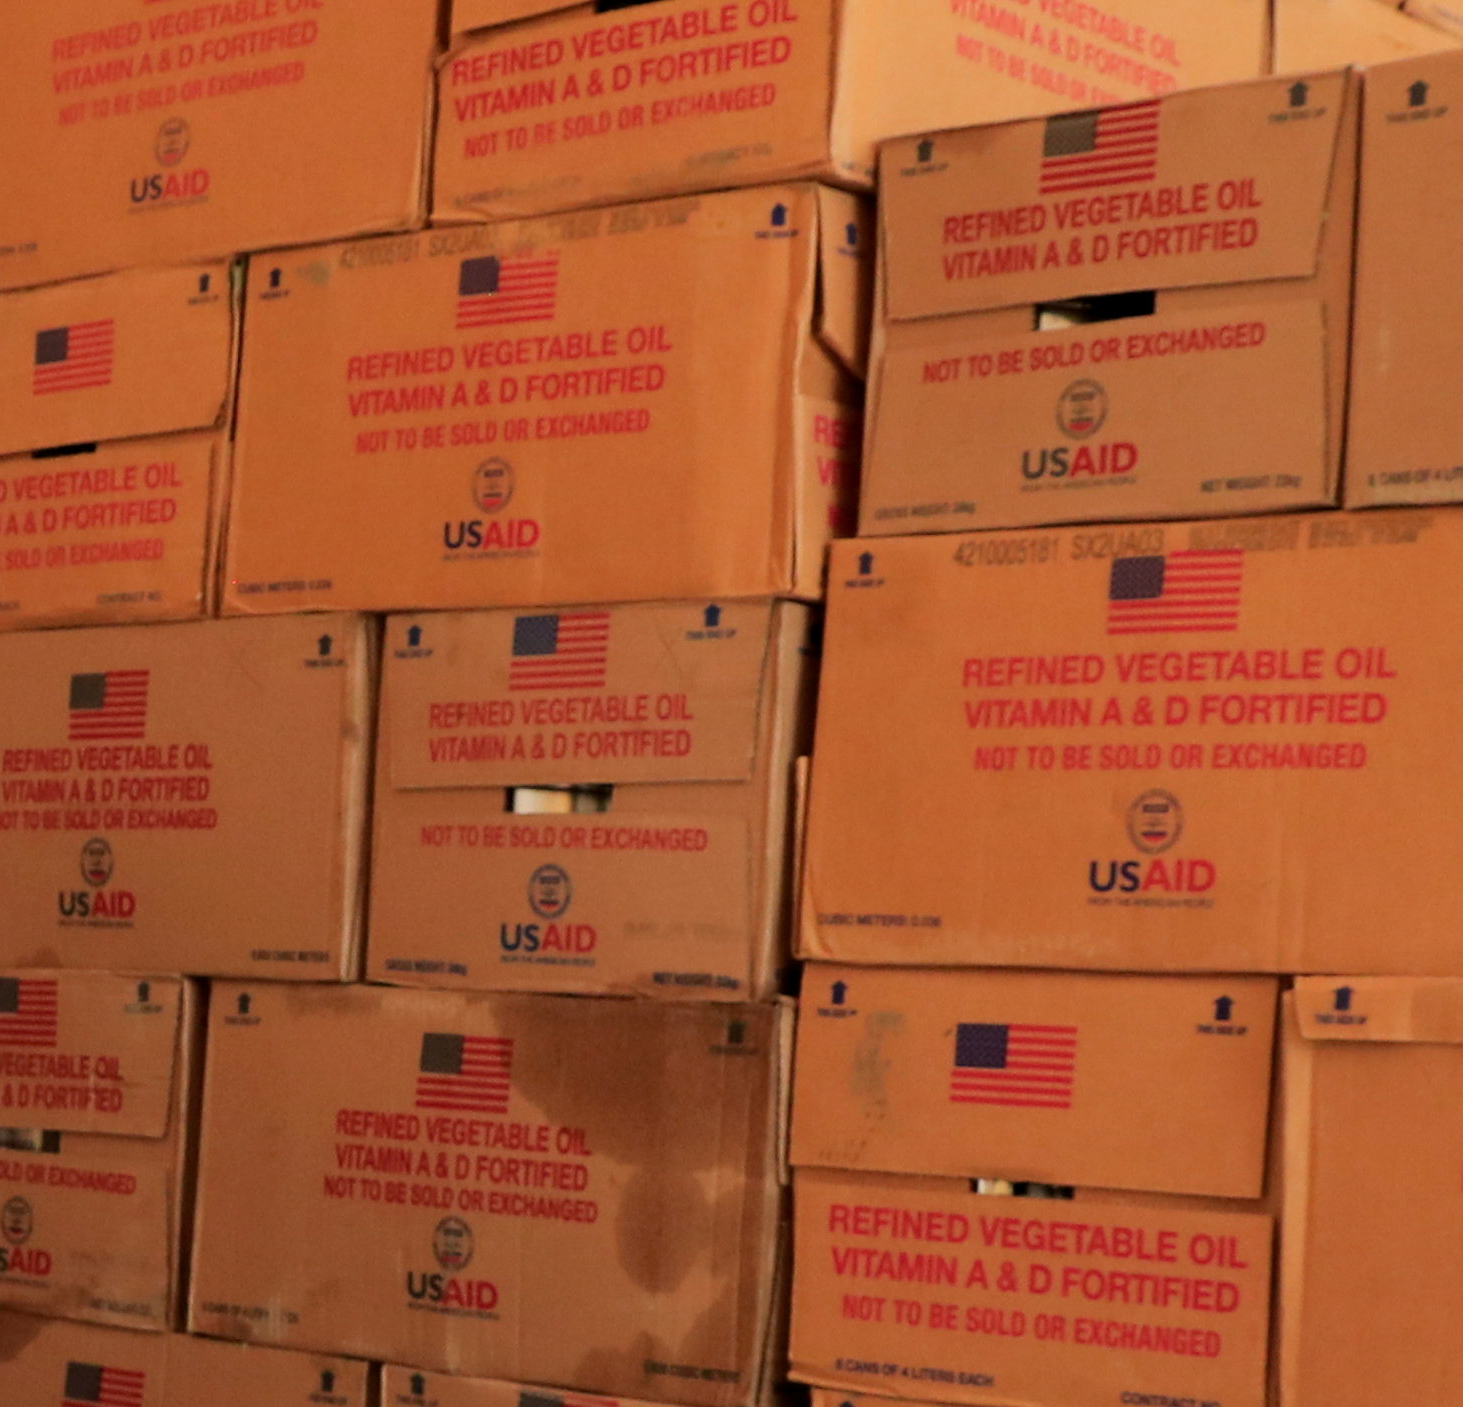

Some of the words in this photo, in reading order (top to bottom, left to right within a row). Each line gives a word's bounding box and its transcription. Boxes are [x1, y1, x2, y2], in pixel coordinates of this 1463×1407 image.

[944, 204, 1047, 244] REFINED
[1054, 184, 1208, 230] VEGETABLE
[1217, 177, 1261, 211] OIL
[943, 243, 1037, 279] VITAMIN
[1042, 241, 1060, 268] A
[1066, 236, 1084, 266] &
[1091, 233, 1110, 263] D
[1117, 216, 1258, 261] FORTIFIED
[347, 346, 455, 381] REFINED
[463, 330, 617, 369] VEGETABLE
[626, 324, 672, 354] OIL
[923, 358, 962, 383] NOT
[968, 354, 993, 378] TO
[997, 349, 1023, 374] BE
[1029, 342, 1085, 370] SOLD
[1089, 337, 1121, 363] OR
[1126, 320, 1266, 359] EXCHANGED
[349, 384, 446, 415] VITAMIN
[451, 381, 468, 406] A
[474, 379, 492, 406] &
[499, 376, 519, 403] D
[525, 363, 666, 401] FORTIFIED
[356, 430, 390, 453] NOT
[396, 427, 418, 449] TO
[422, 425, 444, 448] BE
[451, 420, 498, 445] SOLD
[503, 418, 529, 441] OR
[535, 408, 650, 439] EXCHANGED
[1023, 442, 1138, 479] USAID
[444, 518, 539, 549] USAID
[952, 536, 1058, 567] 4210005181
[963, 655, 1105, 686] REFINED
[1116, 648, 1323, 683] VEGETABLE
[1335, 647, 1396, 678] OIL
[430, 700, 515, 728] REFINED
[521, 695, 649, 725] VEGETABLE
[655, 693, 694, 721] OIL
[965, 698, 1092, 727] VITAMIN
[1100, 697, 1123, 725] A
[1132, 696, 1154, 725] &
[1164, 695, 1190, 725] D
[1199, 692, 1387, 725] FORTIFIED
[429, 735, 507, 761] VITAMIN
[511, 735, 526, 758] A
[531, 733, 546, 759] &
[551, 732, 568, 758] D
[573, 728, 691, 758] FORTIFIED
[975, 746, 1018, 770] NOT
[1028, 746, 1056, 769] TO
[1062, 745, 1092, 769] BE
[1100, 744, 1162, 768] SOLD
[1170, 744, 1204, 768] OR
[1211, 743, 1367, 768] EXCHANGED
[421, 825, 453, 845] NOT
[458, 826, 479, 845] TO
[483, 825, 504, 847] BE
[510, 826, 556, 847] SOLD
[560, 827, 587, 847] OR
[590, 828, 708, 850] EXCHANGED
[1090, 860, 1215, 892] USAID
[501, 923, 596, 952] USAID
